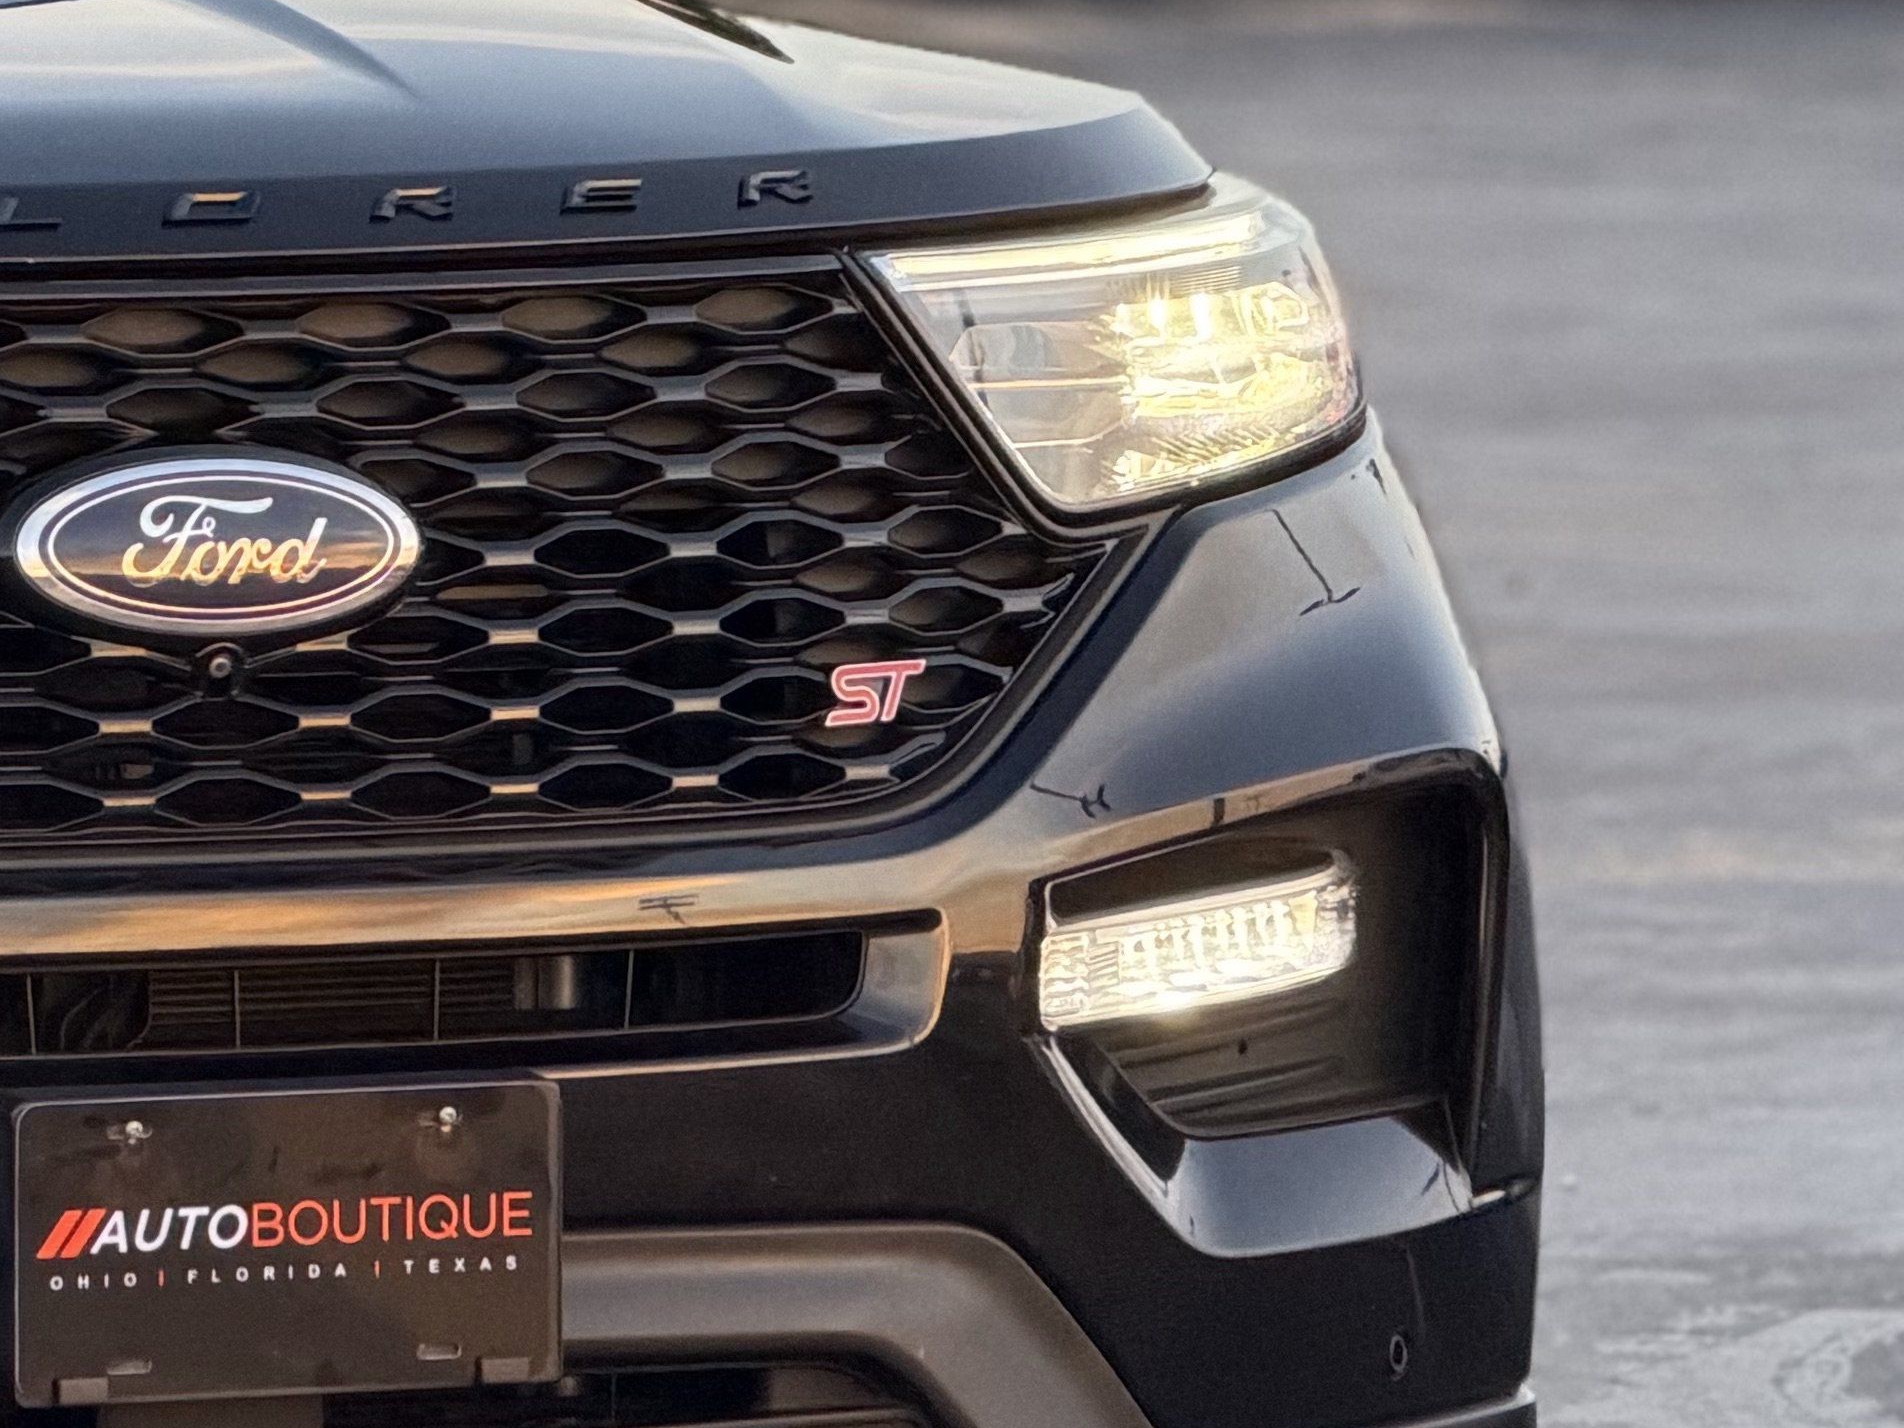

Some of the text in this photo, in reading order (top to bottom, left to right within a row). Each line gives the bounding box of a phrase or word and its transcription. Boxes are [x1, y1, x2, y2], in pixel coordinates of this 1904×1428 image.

[121, 494, 328, 589] Ford
[824, 658, 927, 727] ST
[90, 1190, 534, 1256] AUTOBOUTIQUE
[49, 1255, 518, 1292] OHIO FLORIDA TEXAS
